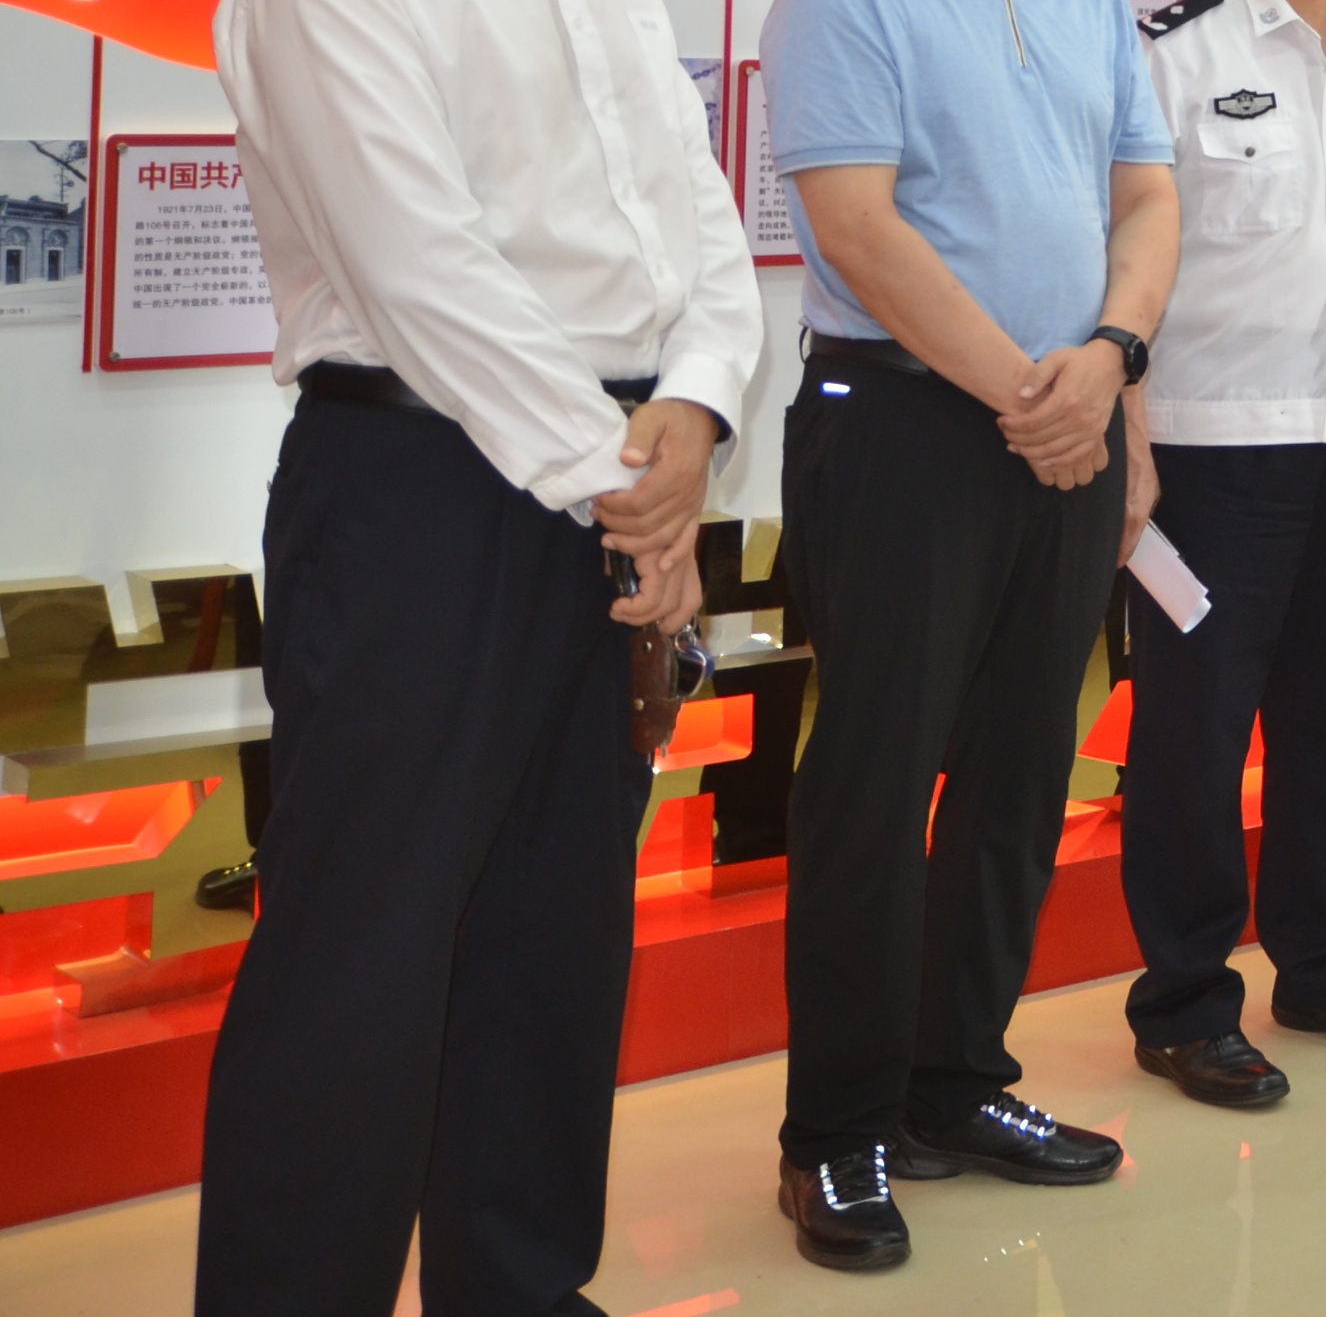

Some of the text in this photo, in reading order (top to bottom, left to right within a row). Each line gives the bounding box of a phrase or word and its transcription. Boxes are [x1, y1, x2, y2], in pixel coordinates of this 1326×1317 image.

[134, 250, 262, 262] 的性质是无产阶级政党；党的
